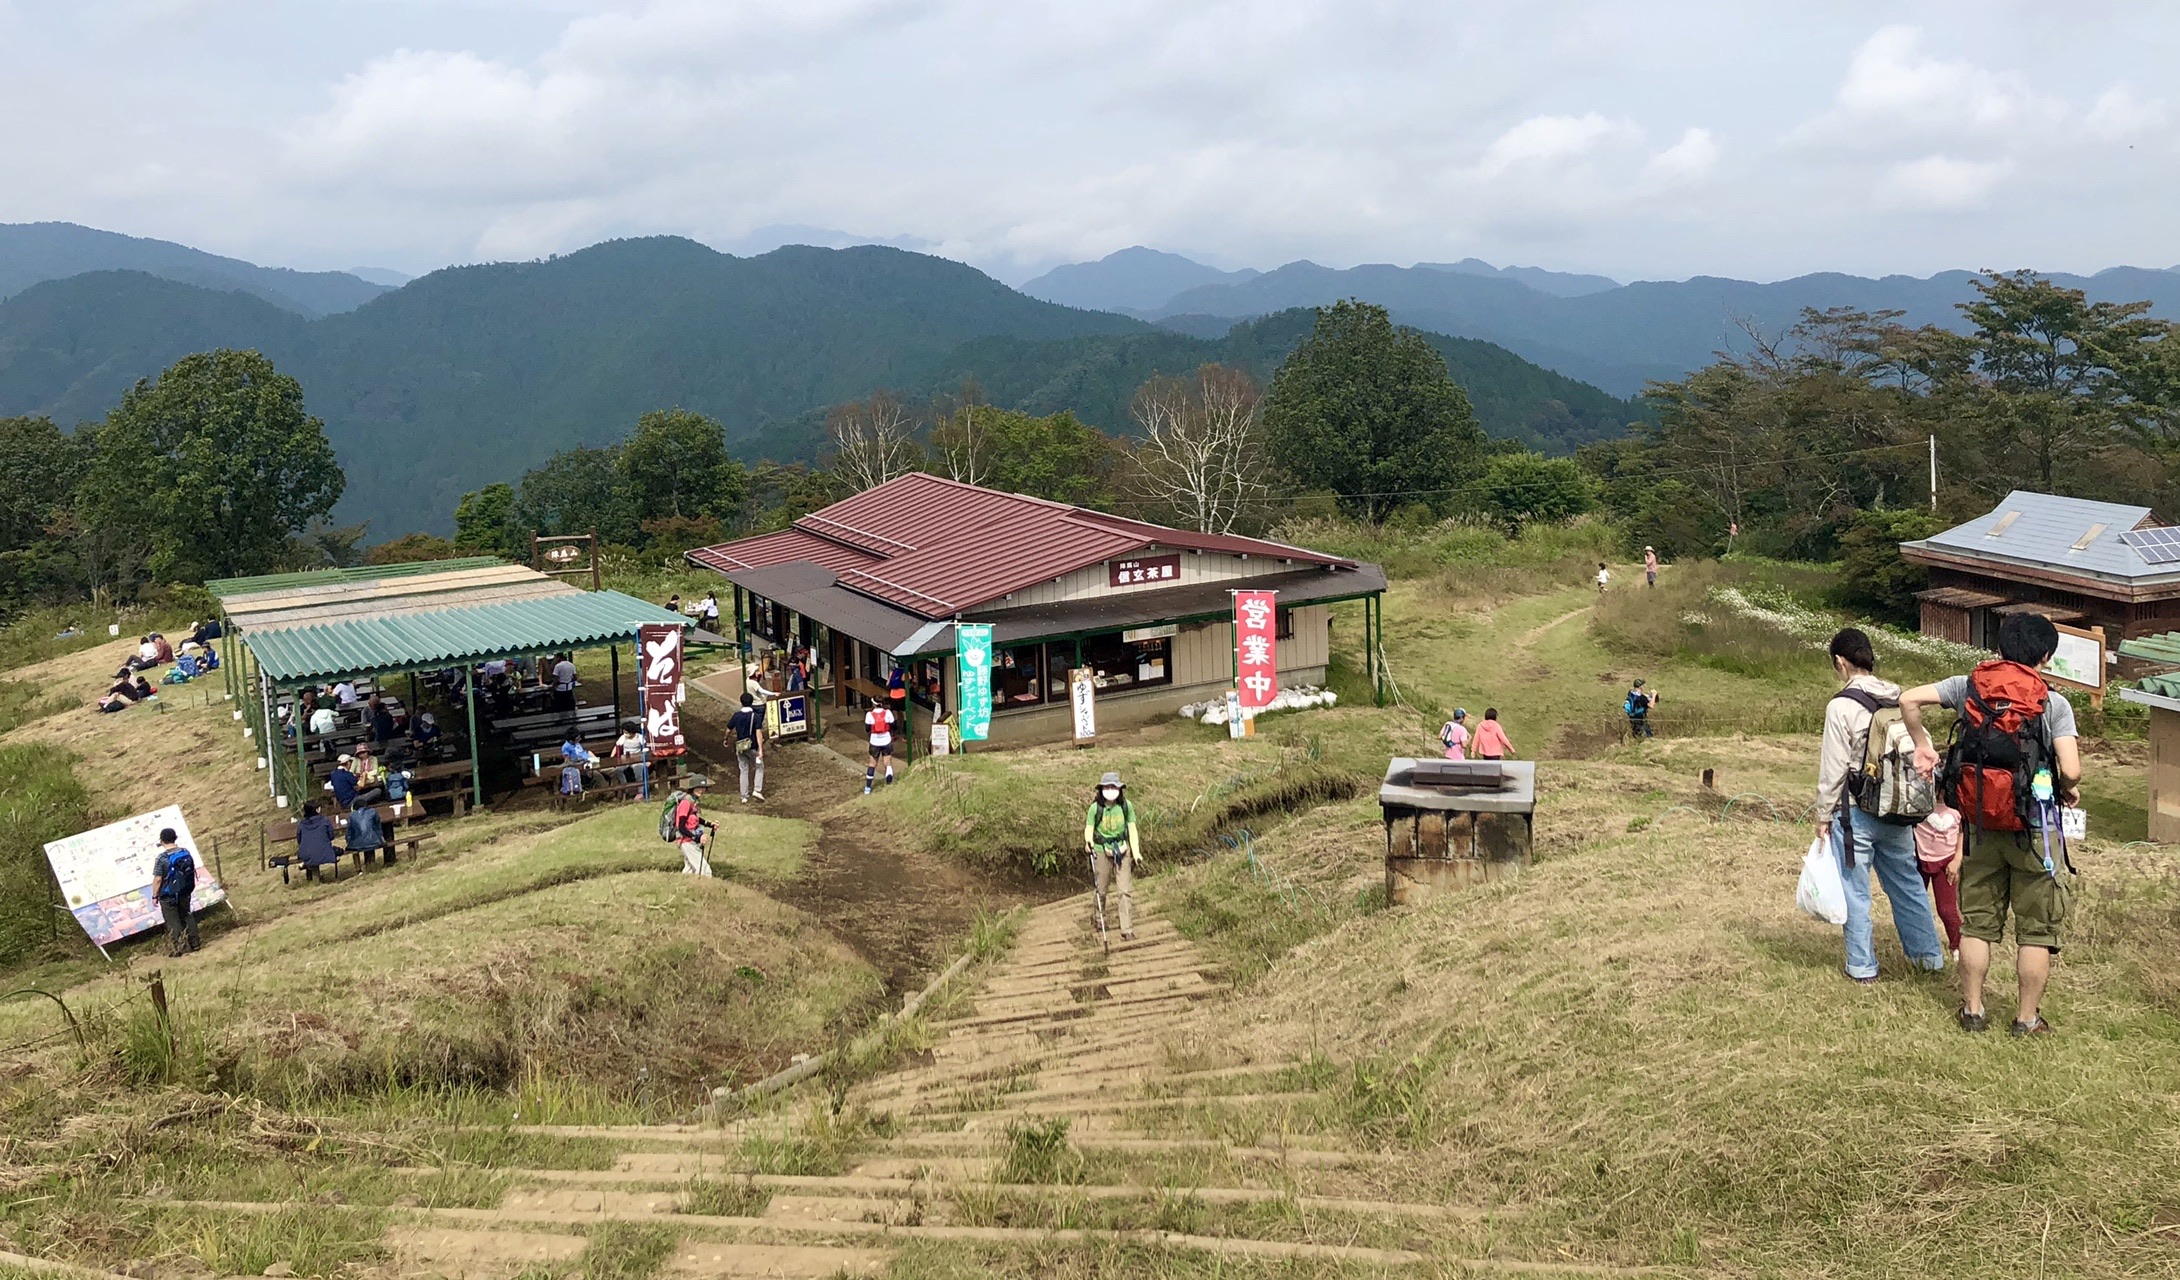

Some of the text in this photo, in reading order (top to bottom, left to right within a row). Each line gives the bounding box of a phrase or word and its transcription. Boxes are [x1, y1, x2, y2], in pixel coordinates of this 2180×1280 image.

[1118, 565, 1173, 583] 信玄茶屋
[646, 629, 679, 738] そば
[1240, 598, 1272, 702] 営業中
